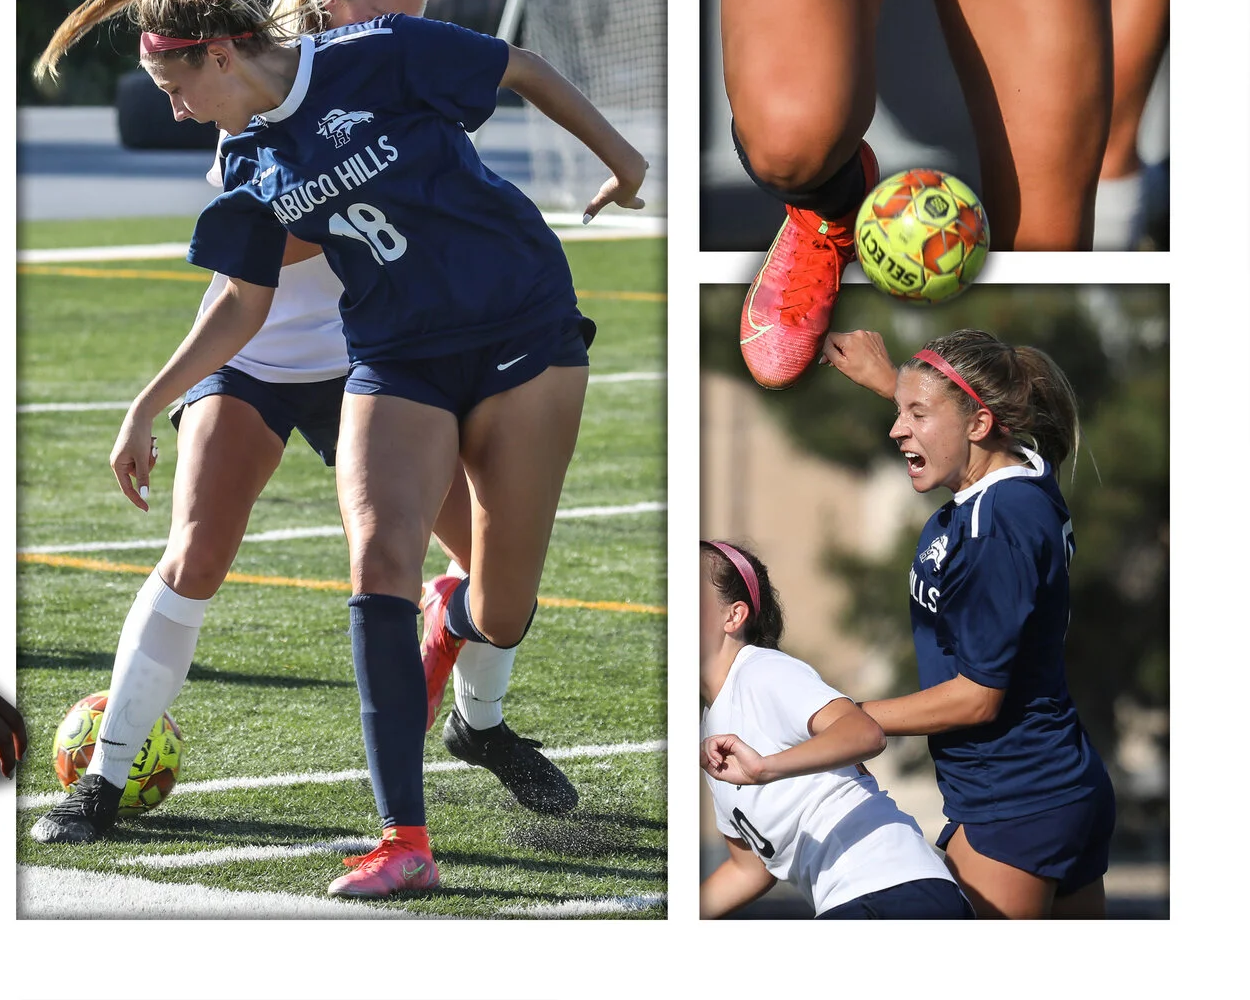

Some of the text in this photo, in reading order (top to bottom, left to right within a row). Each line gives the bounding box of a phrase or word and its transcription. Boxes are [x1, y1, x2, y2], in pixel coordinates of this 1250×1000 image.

[271, 173, 340, 226] ABUCO
[334, 135, 399, 191] HILLS
[328, 202, 408, 266] 18
[861, 230, 918, 287] SELECT
